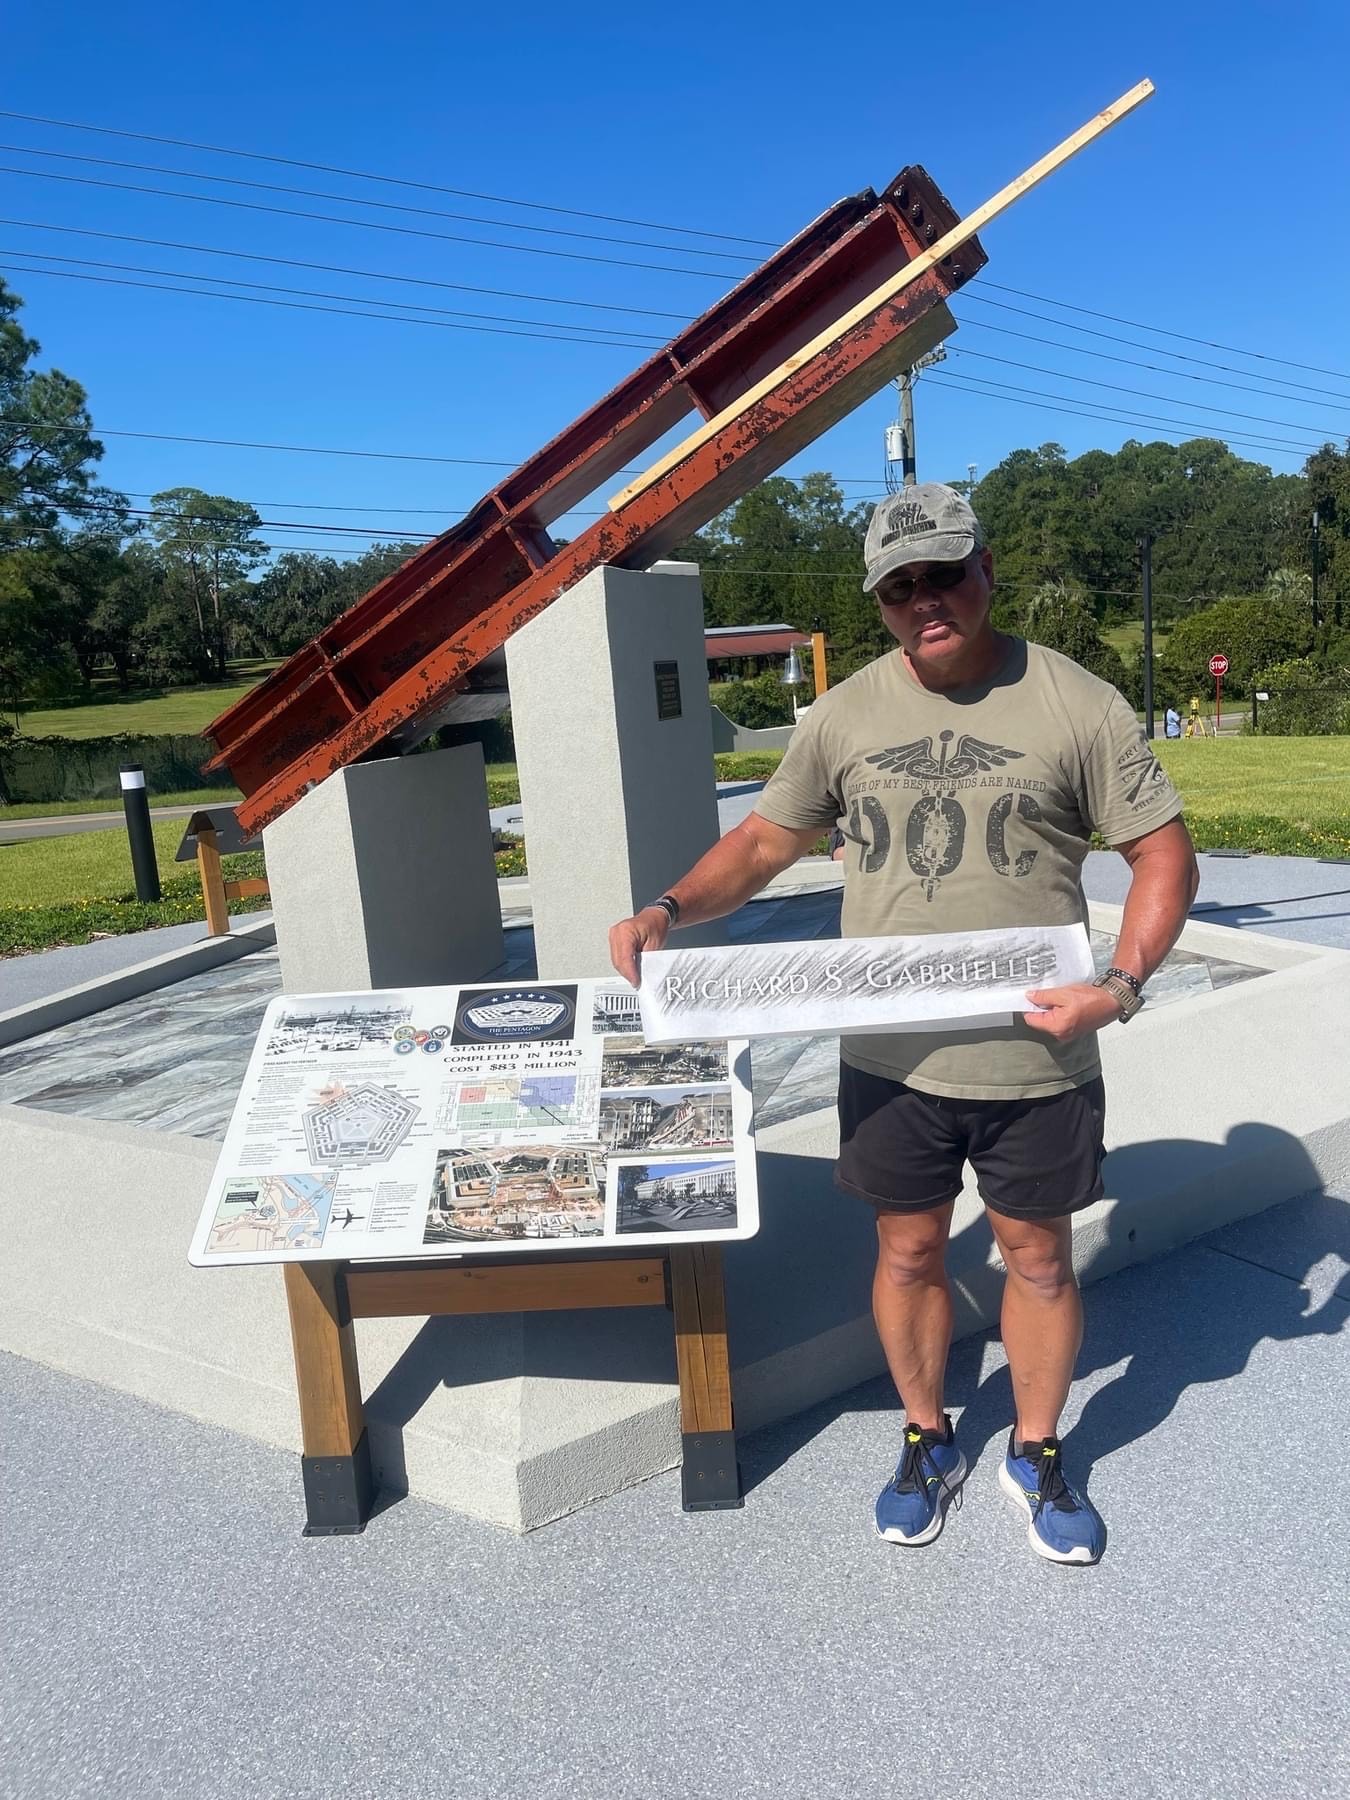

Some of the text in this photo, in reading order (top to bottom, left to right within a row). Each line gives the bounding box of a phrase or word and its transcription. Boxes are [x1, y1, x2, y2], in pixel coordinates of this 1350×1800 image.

[1211, 661, 1226, 670] STOP
[868, 780, 881, 791] OF
[883, 778, 900, 789] MY
[902, 778, 930, 790] BEST
[932, 777, 977, 791] FRIENDS
[980, 776, 1004, 787] ARE
[1006, 777, 1047, 792] NAMED
[503, 1025, 541, 1033] PENTAGON
[453, 1043, 511, 1053] STARTED
[540, 1040, 571, 1048] 1941
[443, 1053, 520, 1063] COMPLETED
[549, 1049, 583, 1058] 1943
[449, 1061, 577, 1073] COST $83 MILLION
